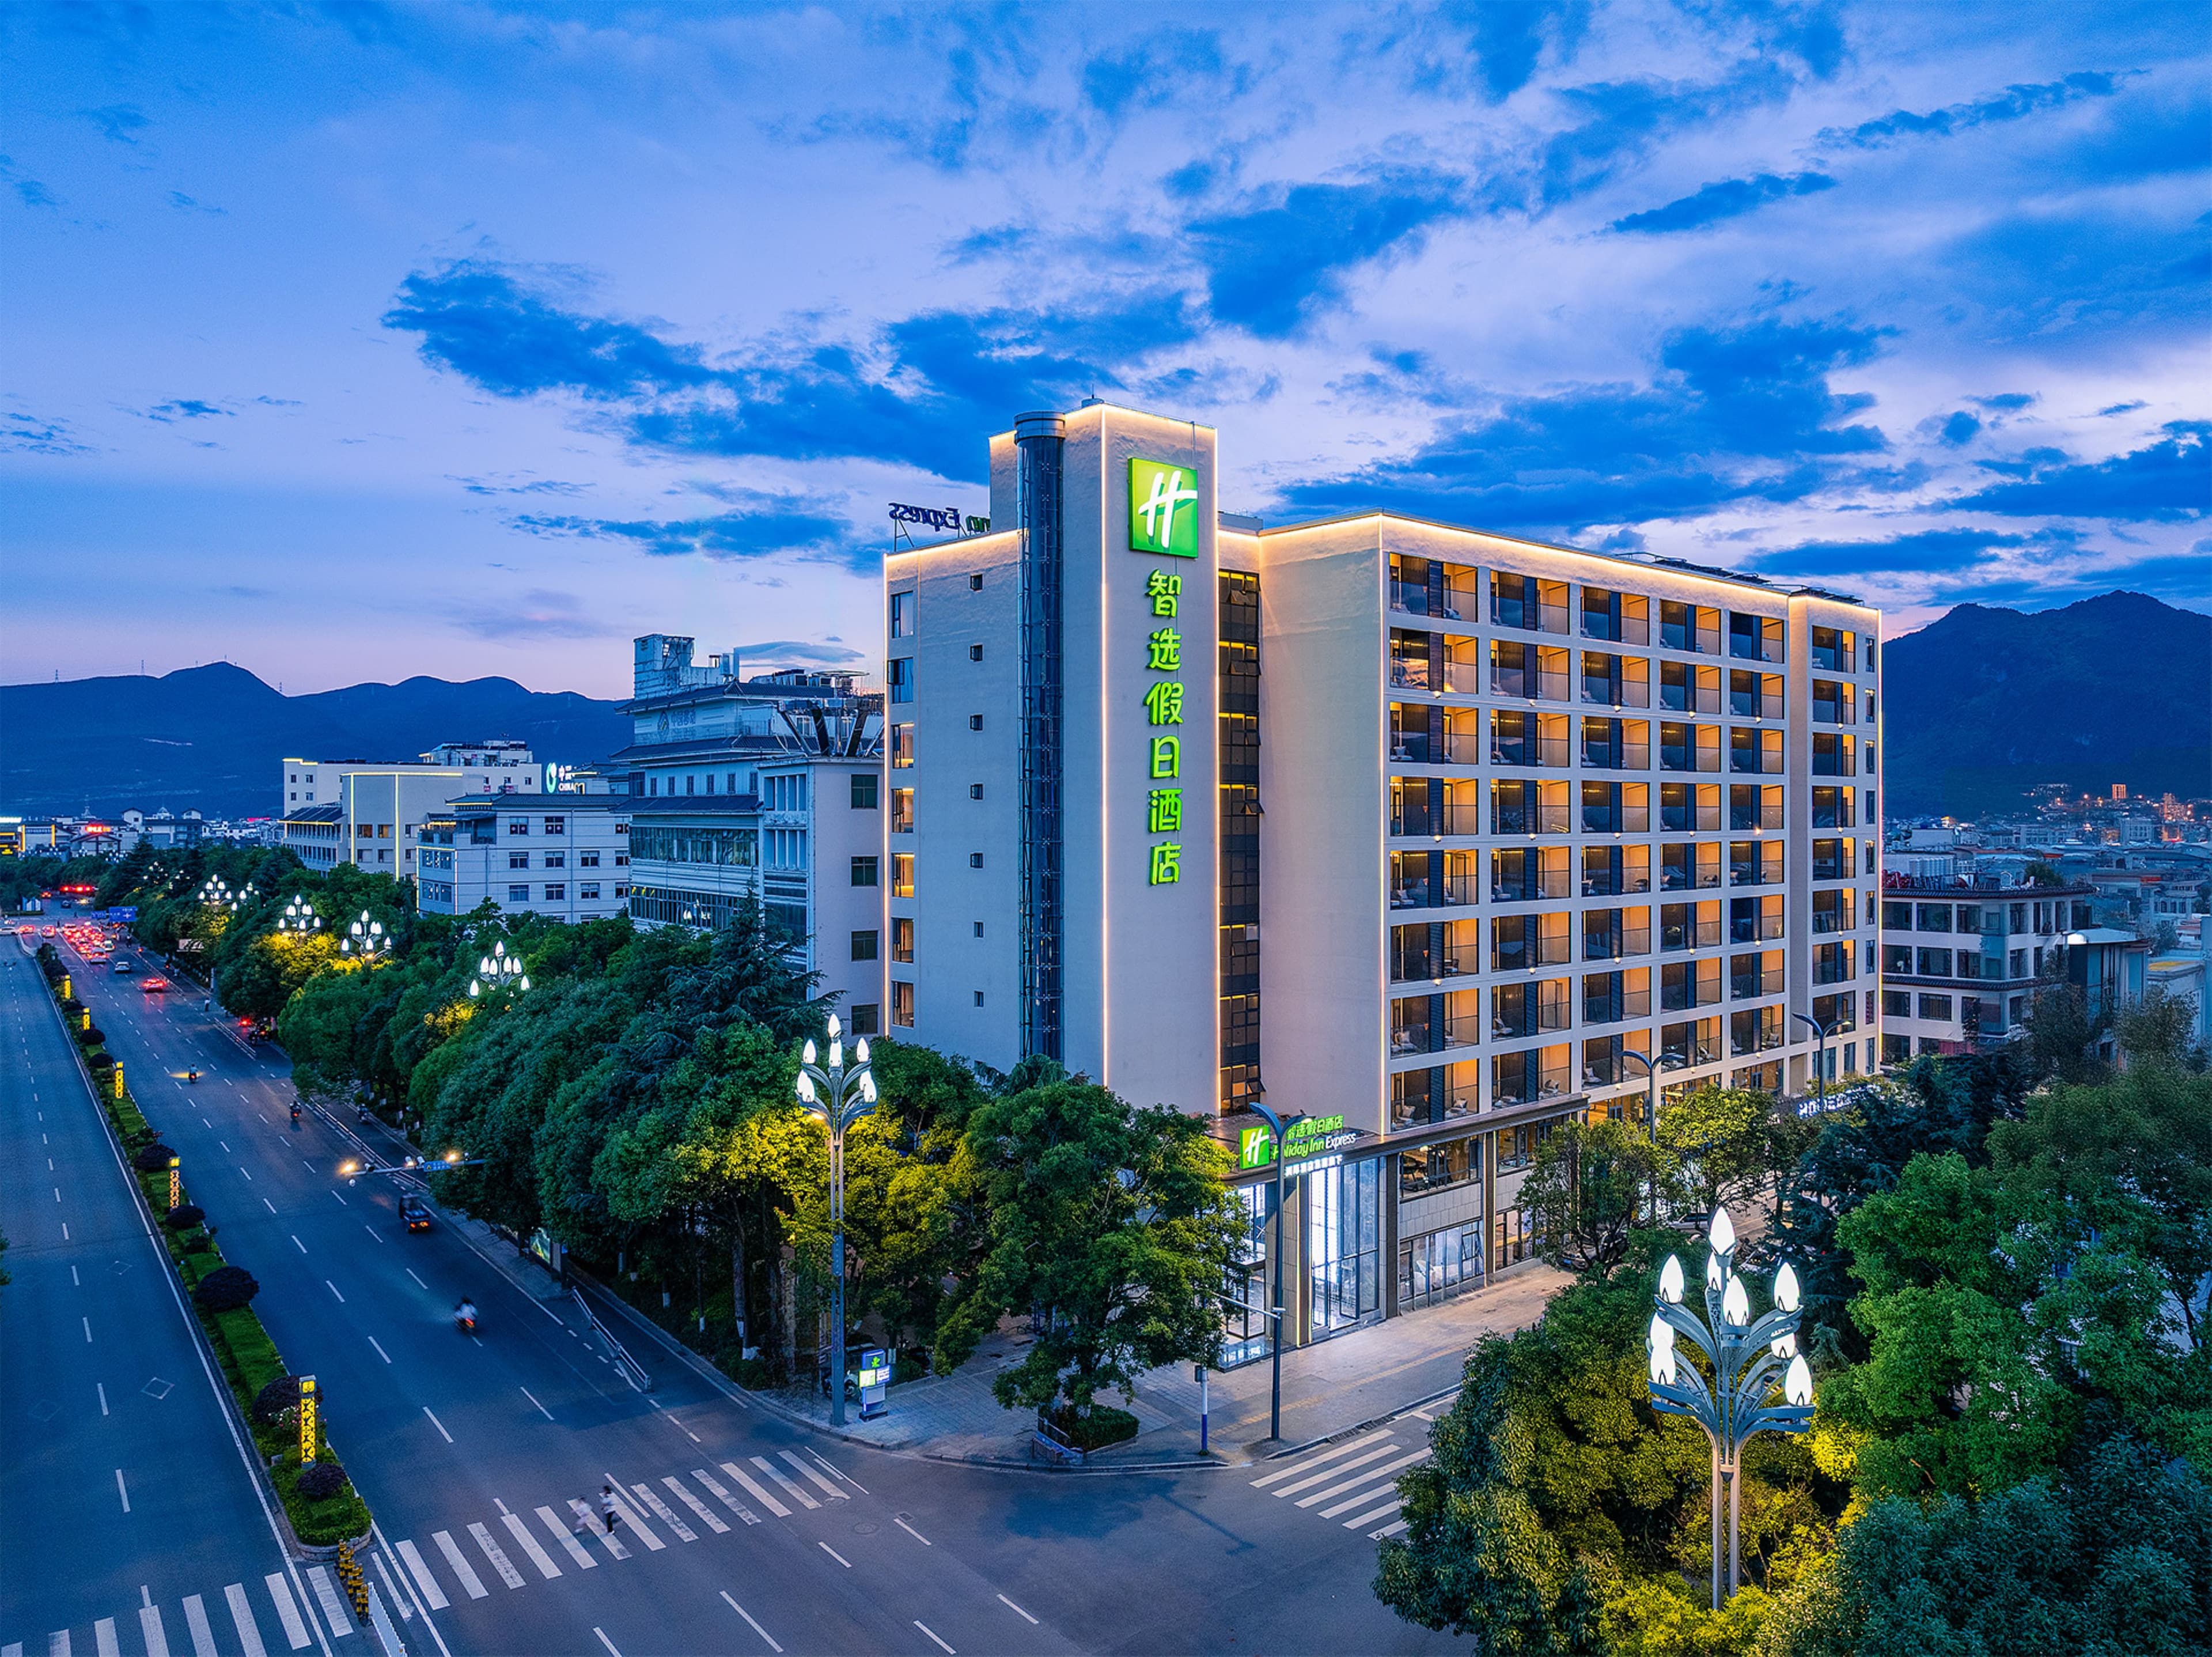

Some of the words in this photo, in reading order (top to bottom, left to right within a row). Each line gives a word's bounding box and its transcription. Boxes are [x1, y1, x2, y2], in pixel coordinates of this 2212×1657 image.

[1145, 569, 1184, 886] 智选假日酒店
[1309, 1137, 1325, 1152] Inn
[1325, 1132, 1357, 1150] Express
